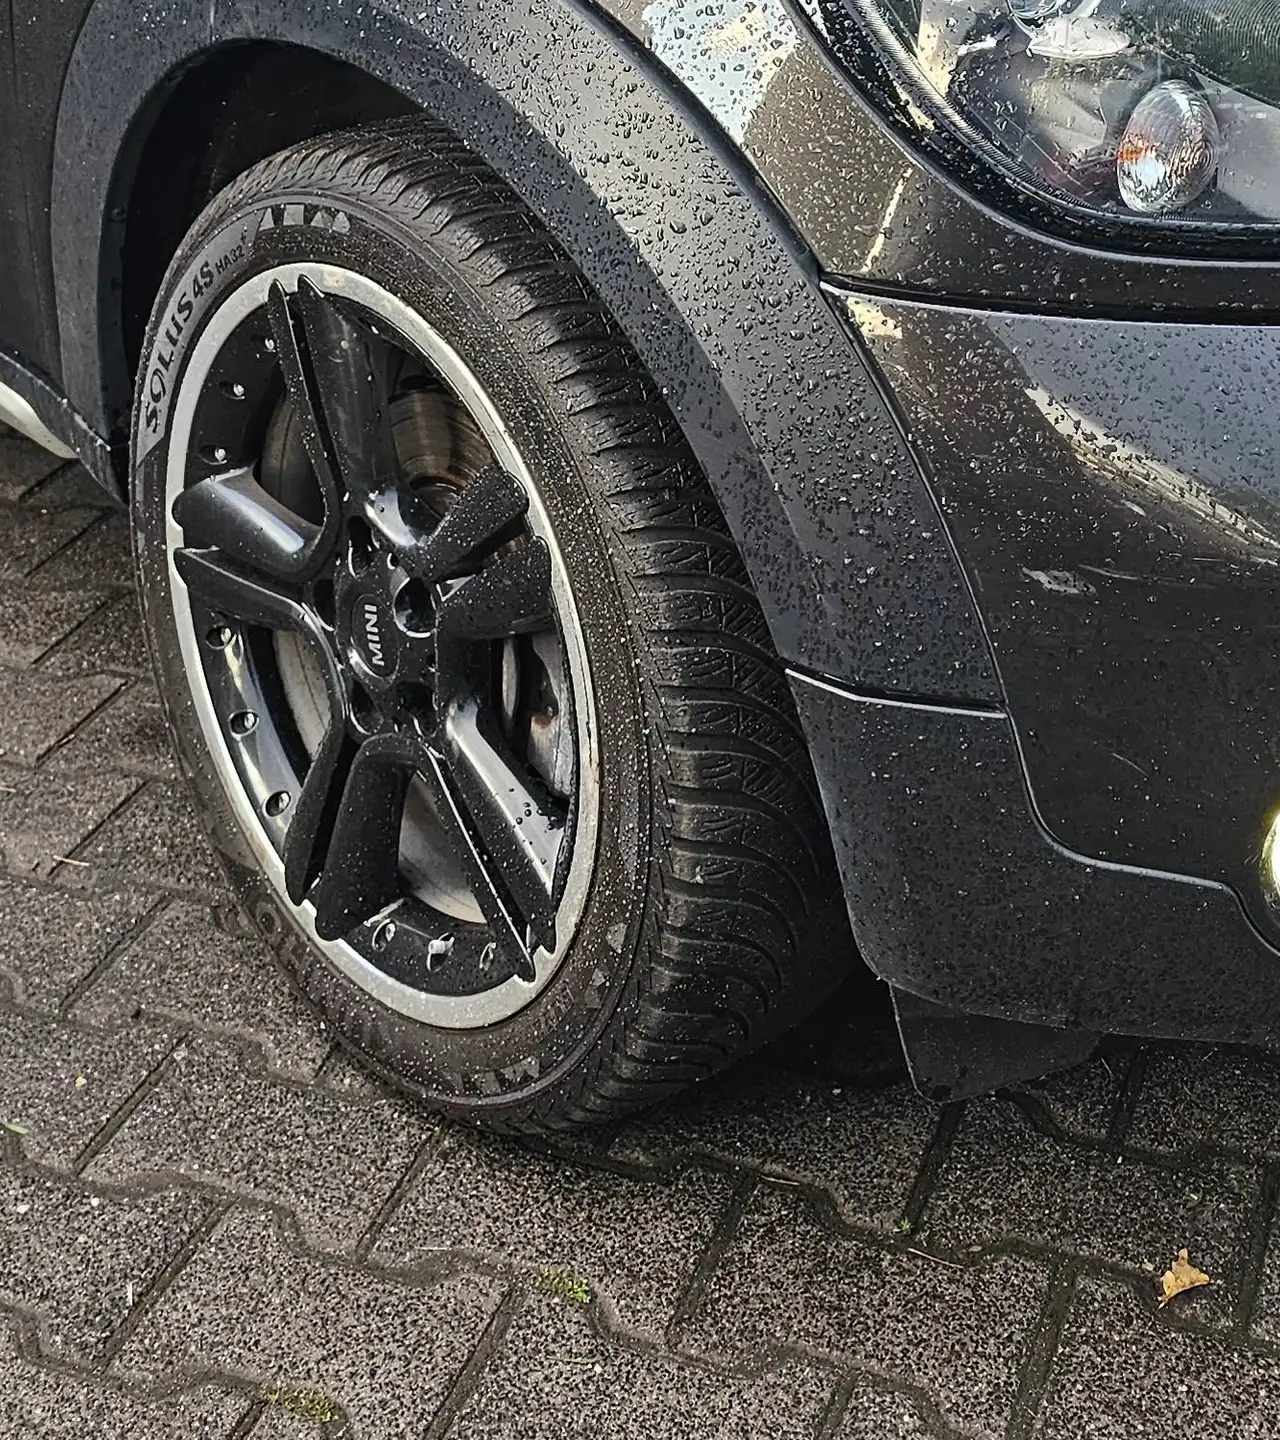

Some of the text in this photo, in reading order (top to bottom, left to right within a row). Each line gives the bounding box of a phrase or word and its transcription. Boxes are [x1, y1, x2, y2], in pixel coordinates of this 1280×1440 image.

[143, 293, 194, 434] SOLUS
[192, 260, 215, 299] 4S
[363, 604, 385, 666] MINI
